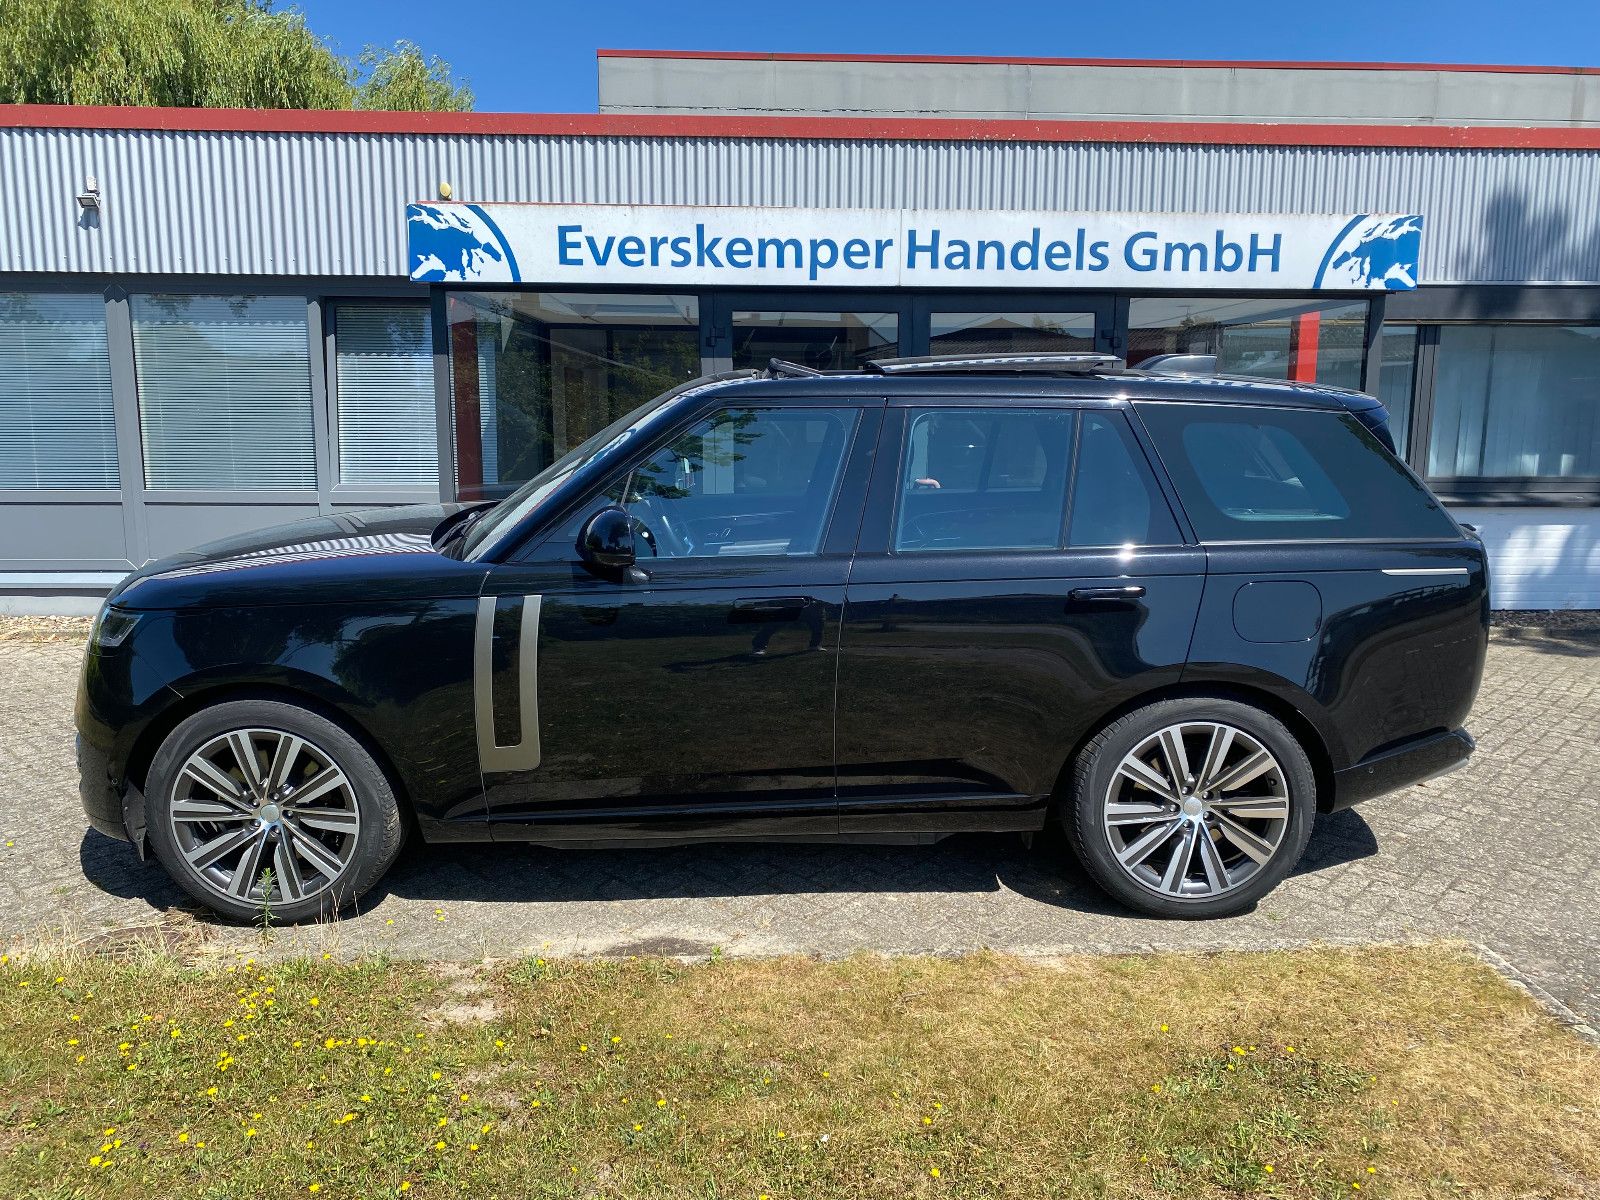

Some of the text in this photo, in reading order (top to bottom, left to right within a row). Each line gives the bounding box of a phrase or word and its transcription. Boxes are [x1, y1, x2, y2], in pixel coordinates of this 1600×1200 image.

[557, 223, 1282, 281] Everskemper Handels GmbH
